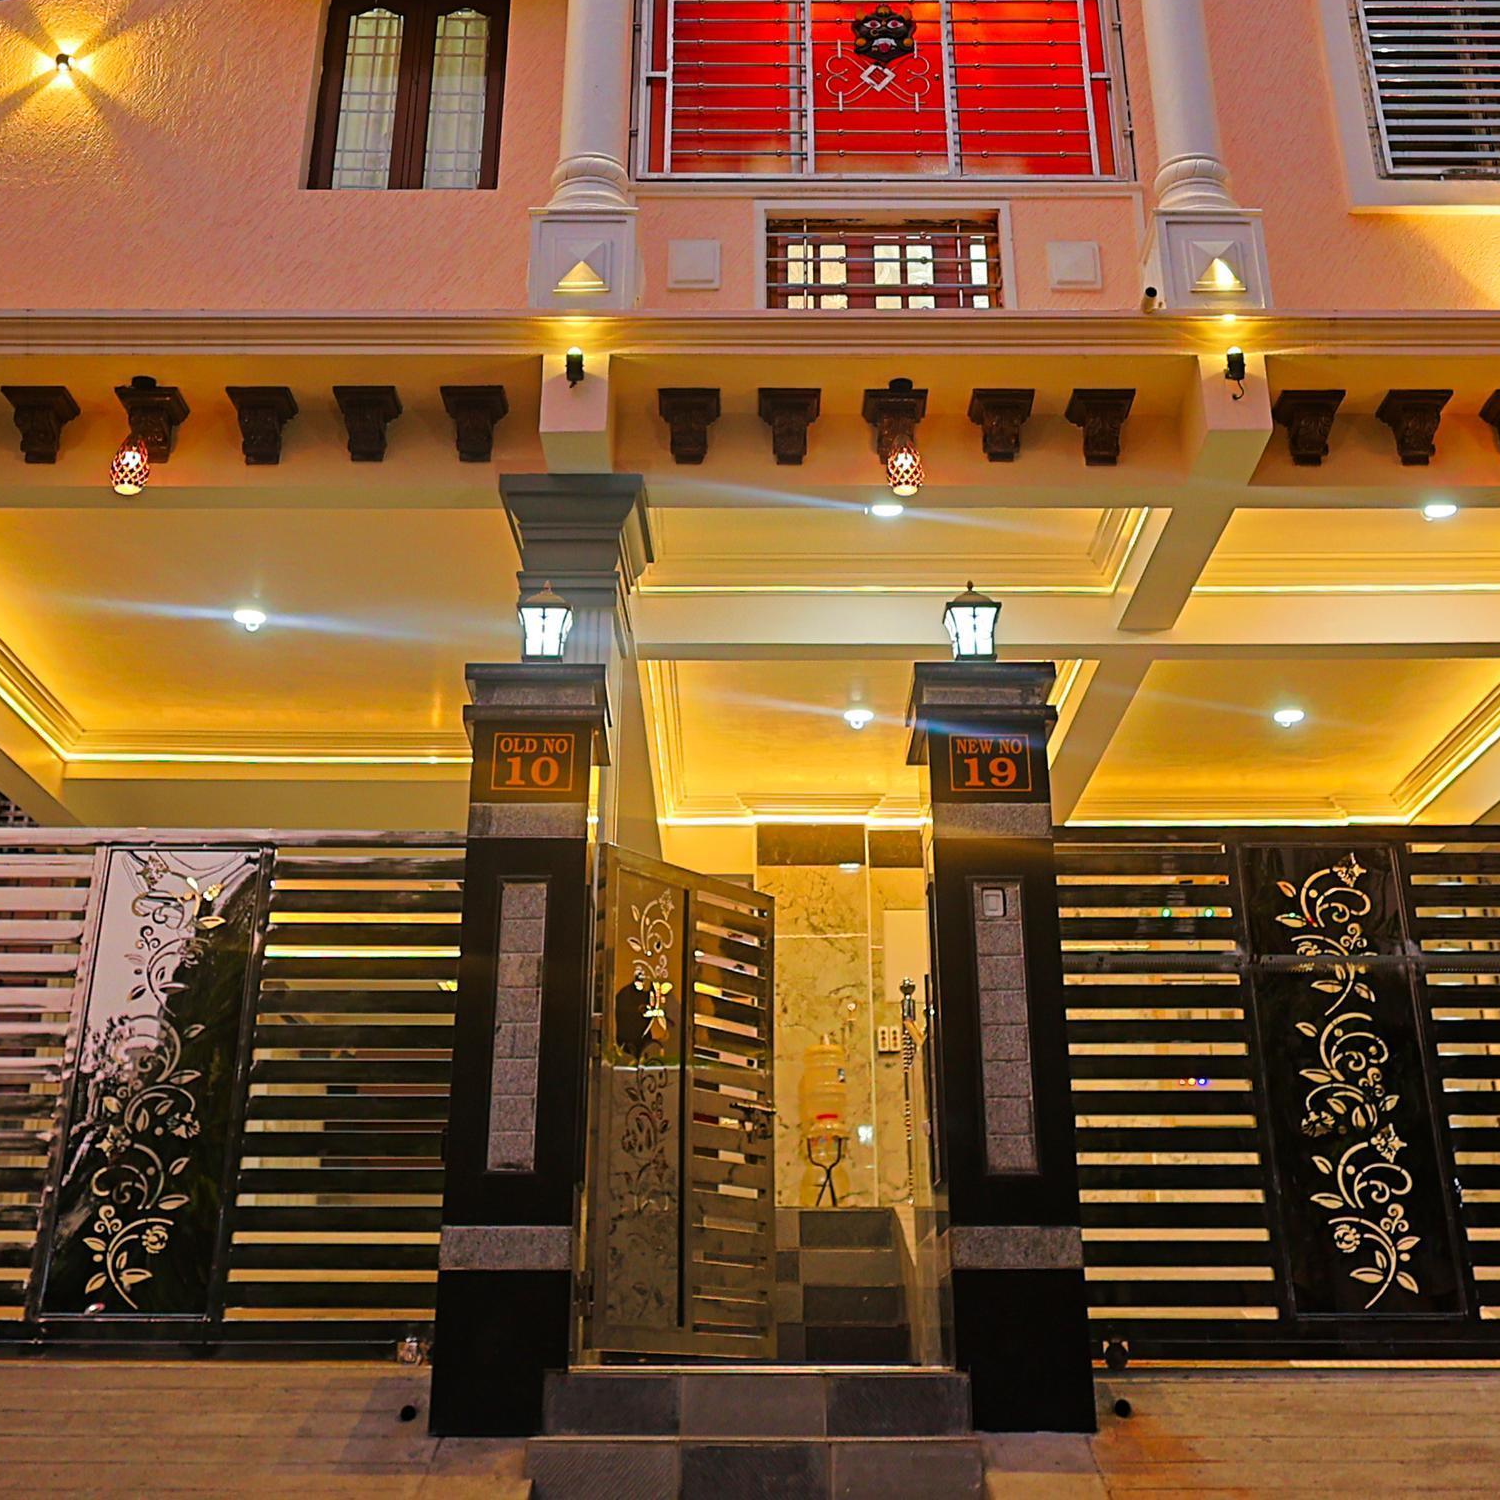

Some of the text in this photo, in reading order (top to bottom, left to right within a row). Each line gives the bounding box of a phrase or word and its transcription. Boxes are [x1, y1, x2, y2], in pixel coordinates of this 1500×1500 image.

[499, 737, 569, 754] OLD NO
[956, 738, 1023, 755] NEW NO
[505, 756, 560, 787] 10
[963, 757, 1018, 787] 19
